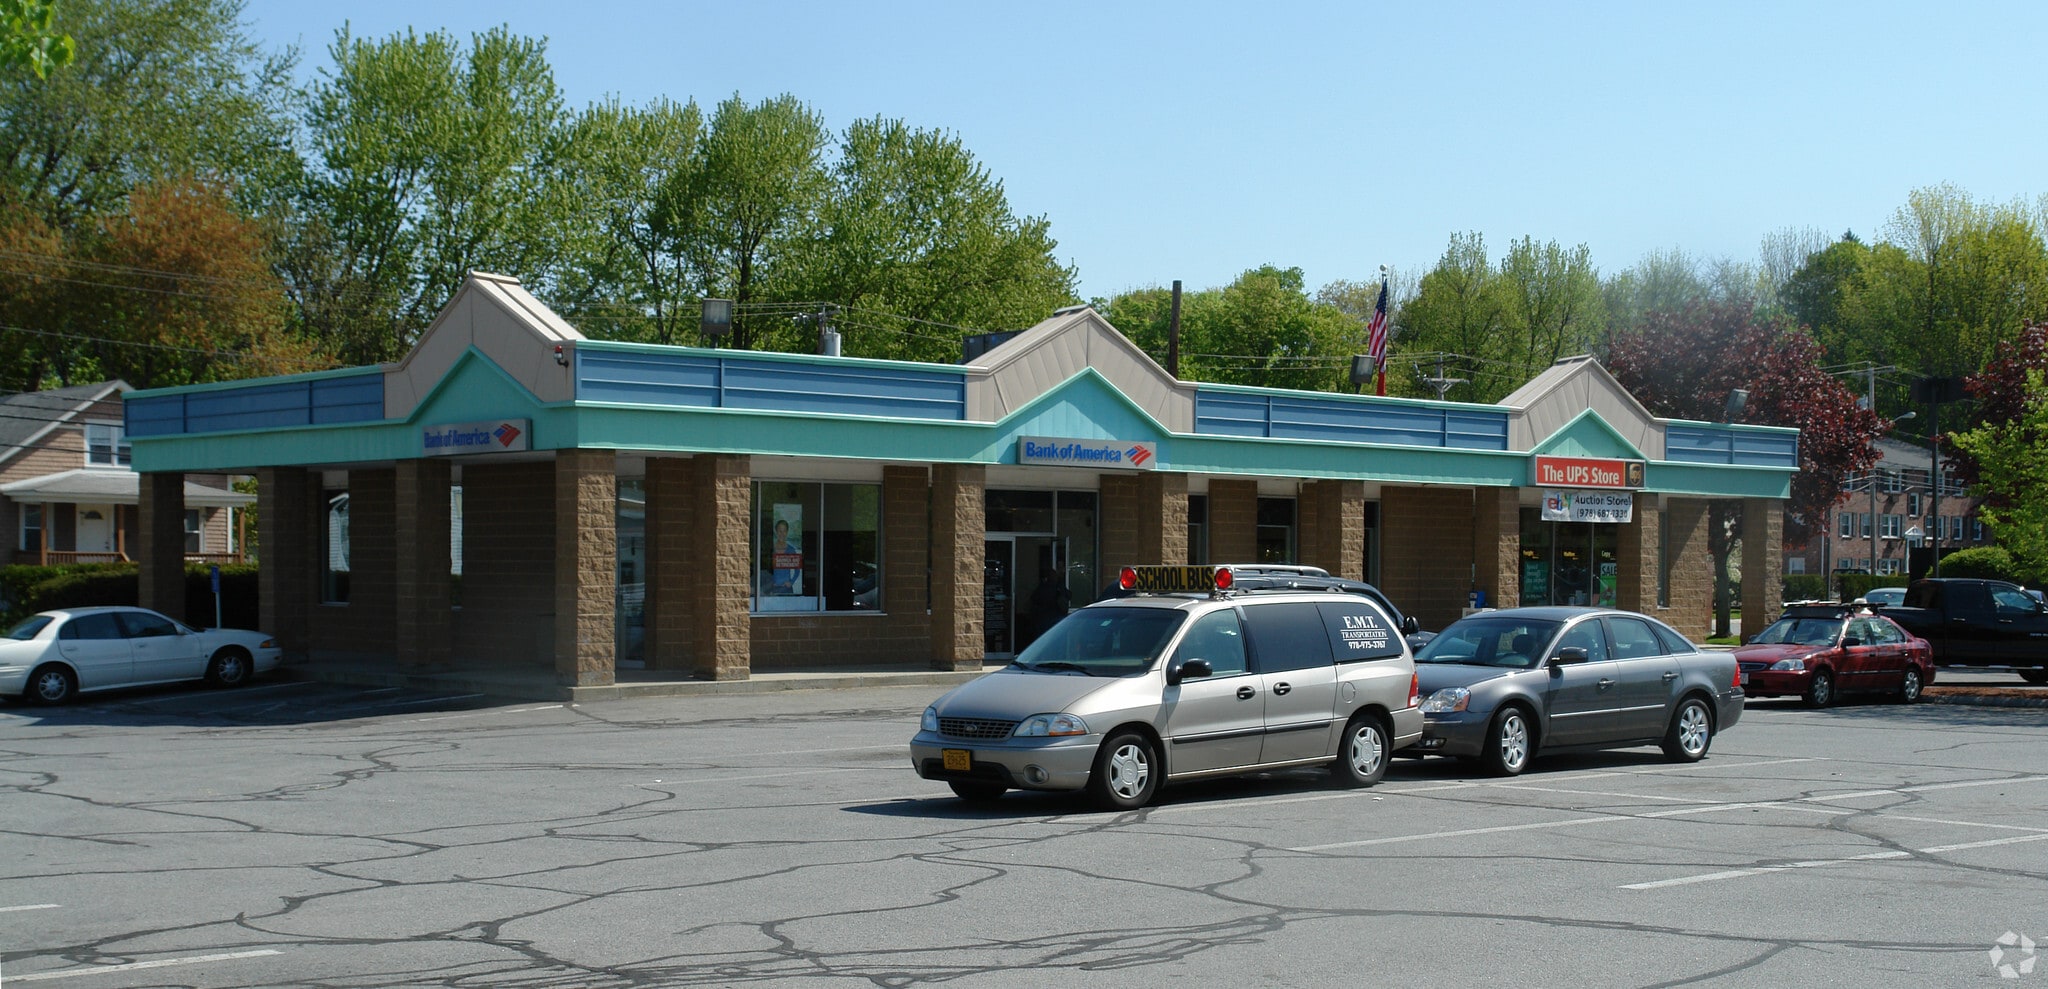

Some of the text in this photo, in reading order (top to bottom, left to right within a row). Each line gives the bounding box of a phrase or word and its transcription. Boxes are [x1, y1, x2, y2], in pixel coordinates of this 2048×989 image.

[424, 428, 490, 448] Bank of America
[1026, 442, 1122, 462] Bank of America
[1543, 464, 1619, 485] The UPS Store
[1574, 495, 1604, 506] Auction
[1137, 567, 1213, 590] SCHOOL BUS
[1342, 615, 1379, 629] E.M.T.
[1341, 631, 1387, 639] TRANSPORTATION
